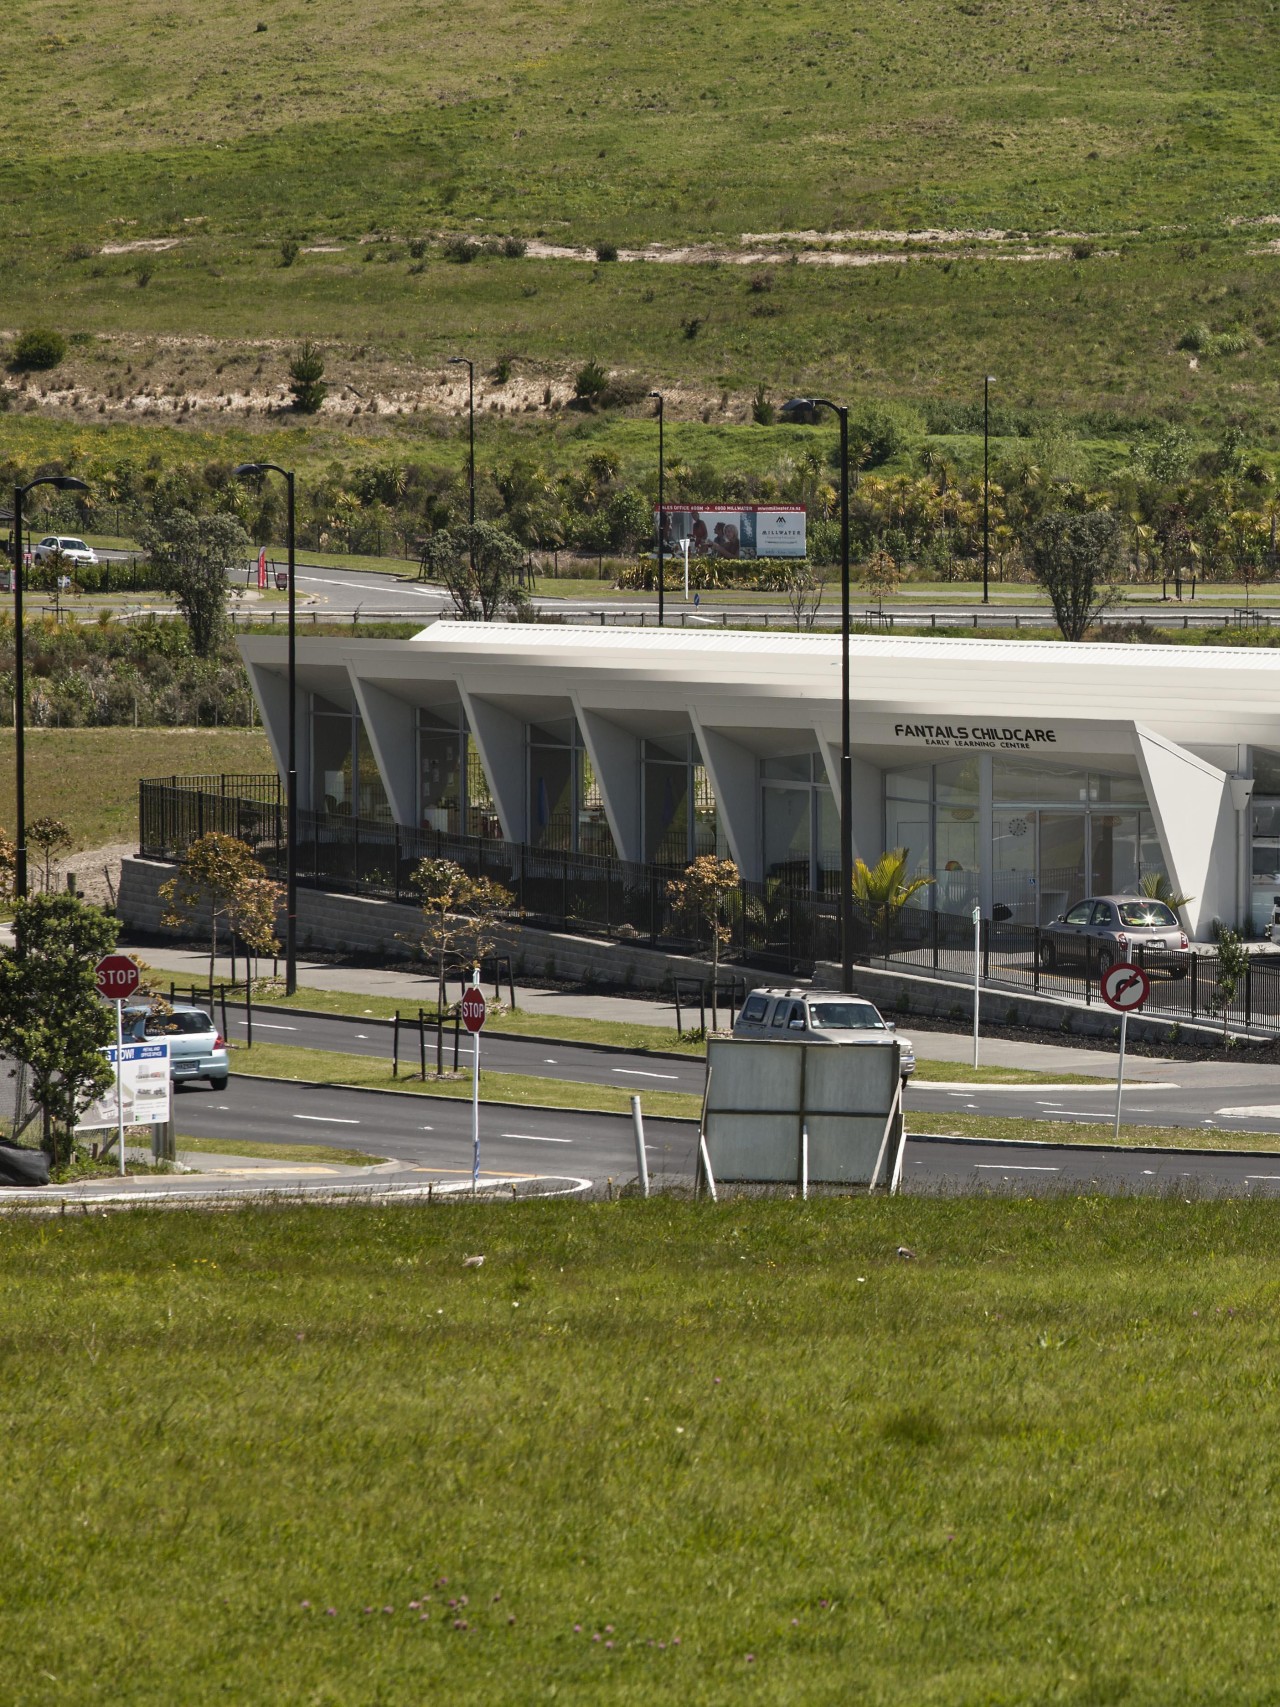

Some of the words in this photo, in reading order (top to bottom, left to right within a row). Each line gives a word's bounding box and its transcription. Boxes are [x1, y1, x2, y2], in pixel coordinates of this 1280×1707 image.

[894, 724, 969, 739] FANTAILS
[971, 727, 1057, 743] CHILDCARE
[925, 738, 950, 746] EARLY
[954, 740, 996, 748] LEARNING
[97, 970, 137, 985] STOP
[463, 1001, 484, 1018] STOP
